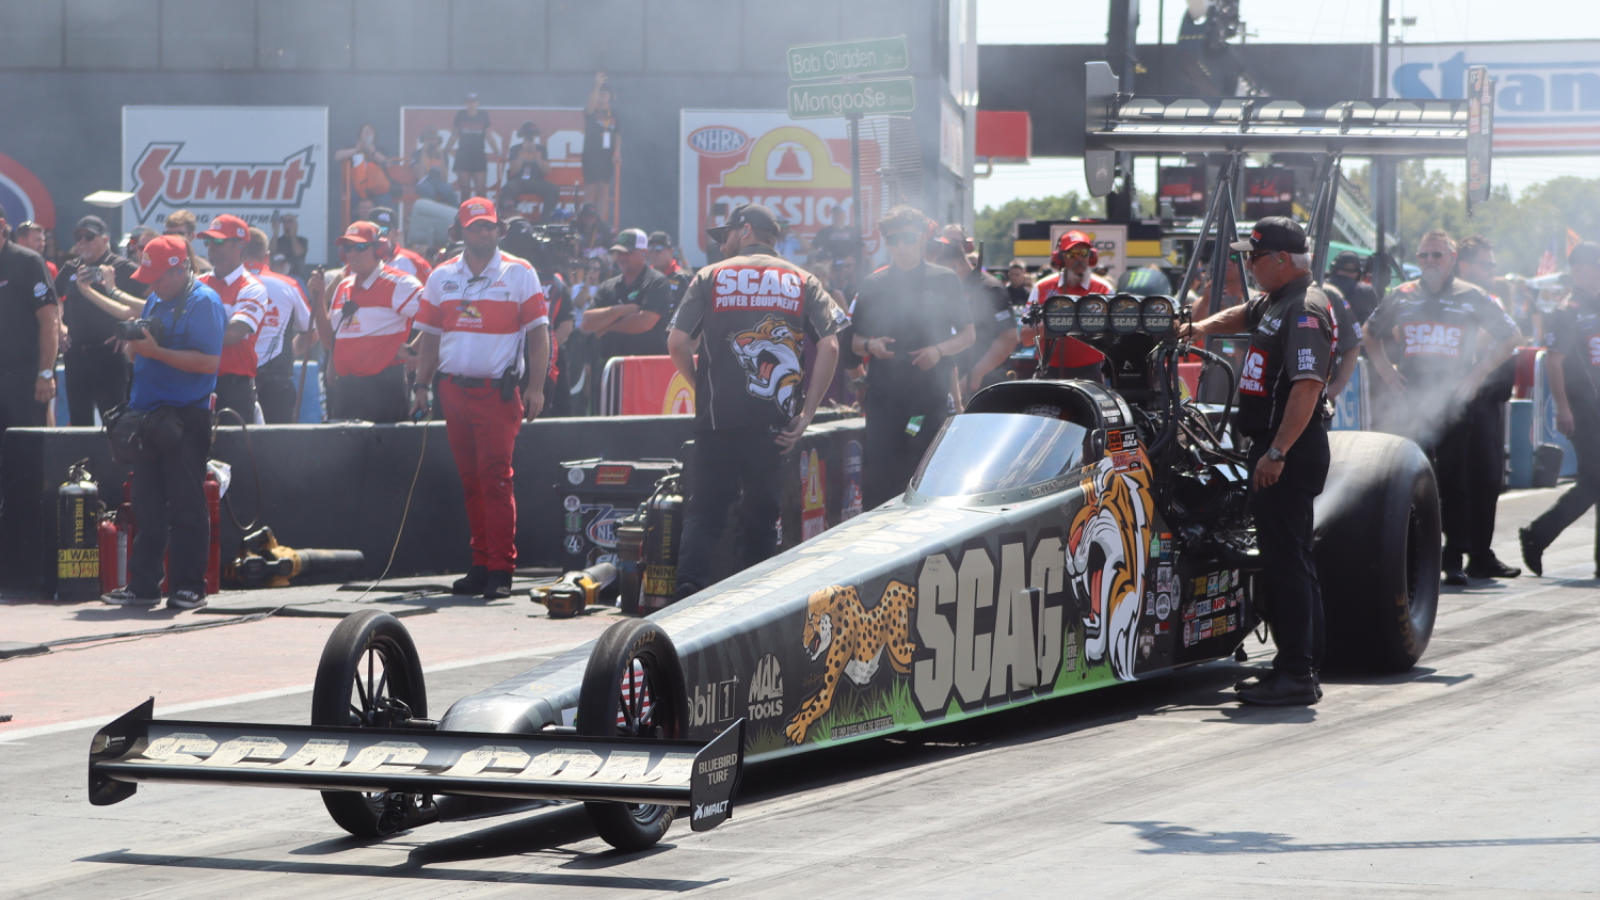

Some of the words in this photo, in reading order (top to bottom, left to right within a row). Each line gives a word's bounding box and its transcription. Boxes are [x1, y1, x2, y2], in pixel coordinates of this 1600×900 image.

[793, 53, 820, 74] Bob
[824, 49, 877, 71] Glidden
[883, 53, 903, 65] Drive
[793, 86, 885, 114] Mongoo$e
[696, 129, 746, 151] NHRA
[716, 268, 801, 299] SCAG
[716, 295, 748, 308] POWER
[750, 296, 799, 311] EQUIPMENT
[1049, 317, 1073, 326] SCAG
[1081, 317, 1105, 326] SCAG
[1113, 318, 1137, 327] SCAG
[1146, 318, 1170, 327] SCAG
[1404, 323, 1461, 347] SCAG
[1423, 346, 1458, 357] EQUIPMENT
[75, 498, 83, 544] FIREBULL
[914, 537, 1064, 712] SCAG
[749, 653, 784, 702] MAC
[688, 682, 716, 728] bil
[748, 700, 783, 721] TOOLS
[699, 753, 738, 774] BLUEBIRD
[707, 768, 729, 786] TURF
